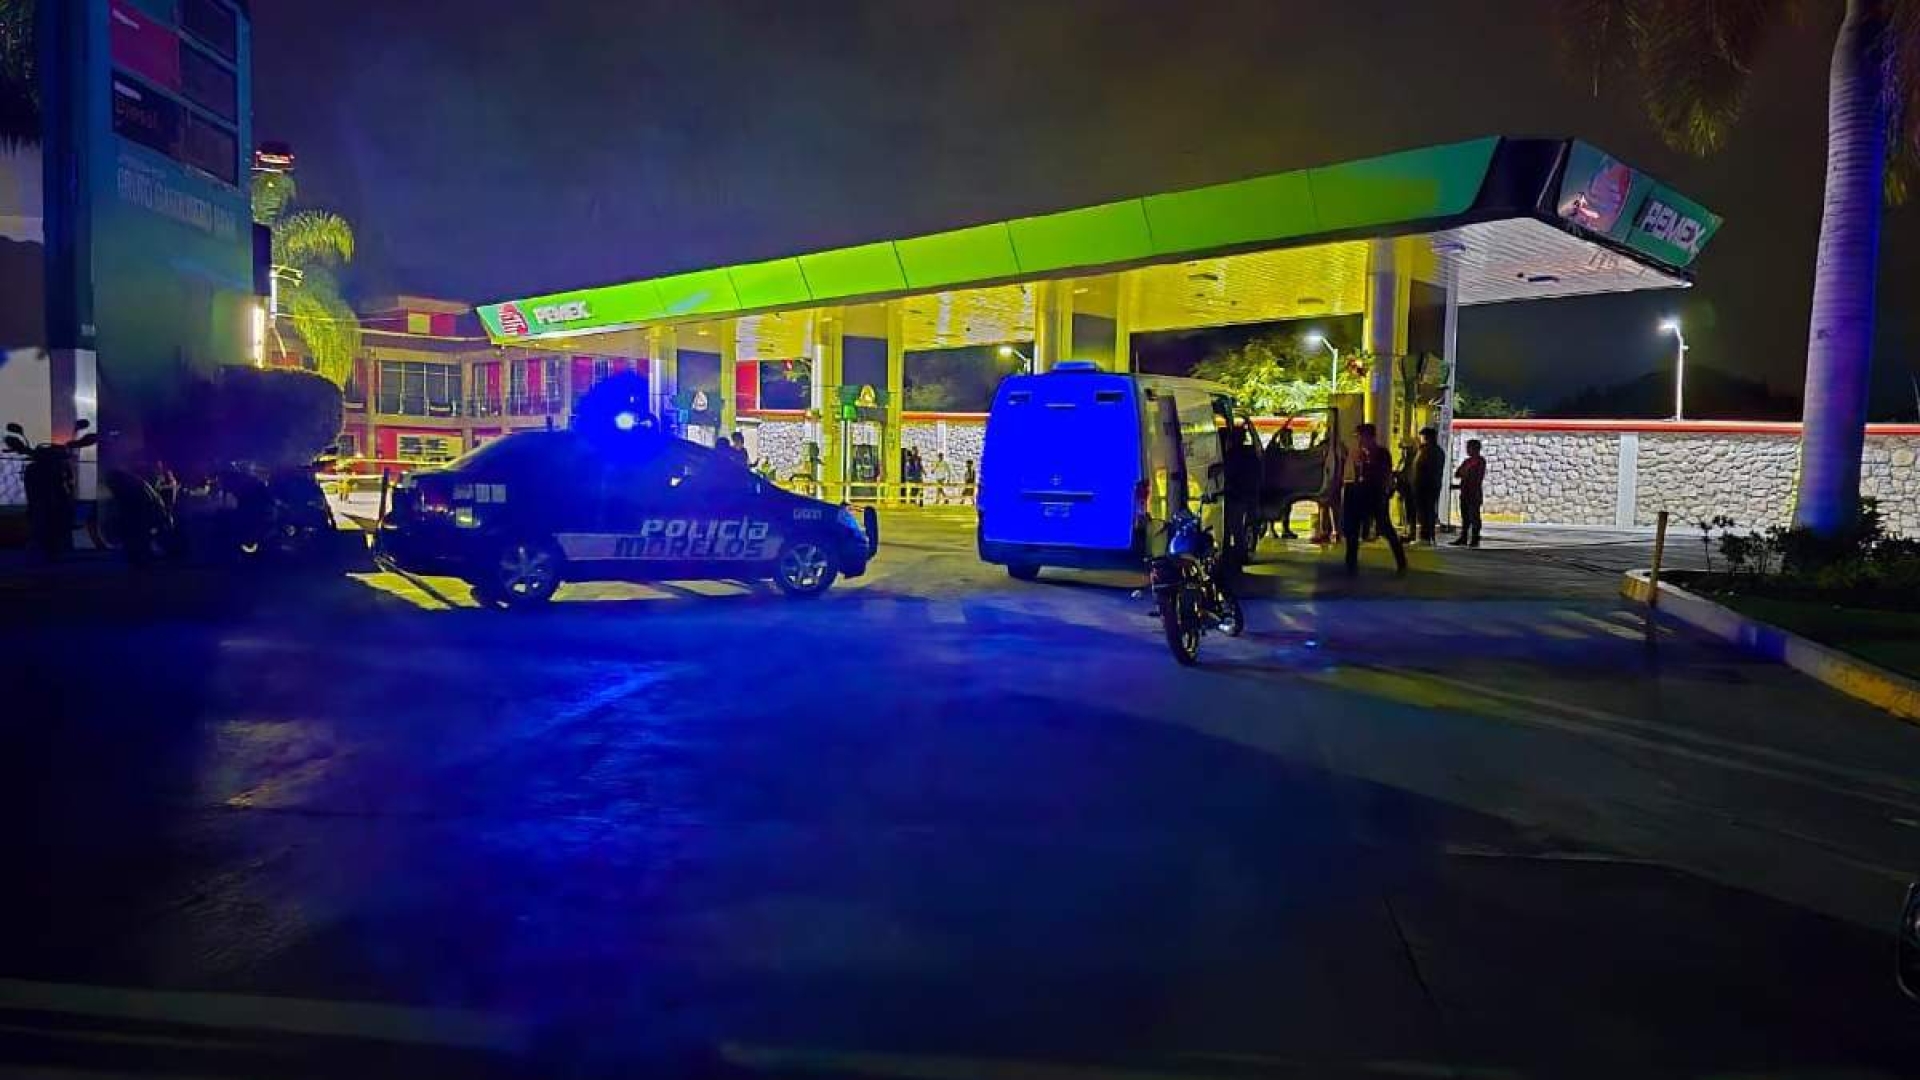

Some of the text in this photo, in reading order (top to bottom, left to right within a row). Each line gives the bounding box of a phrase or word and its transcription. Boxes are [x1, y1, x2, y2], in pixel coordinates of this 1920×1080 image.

[1640, 201, 1706, 252] PEMEX
[533, 301, 590, 324] PEMEX
[615, 537, 764, 559] MORELOS
